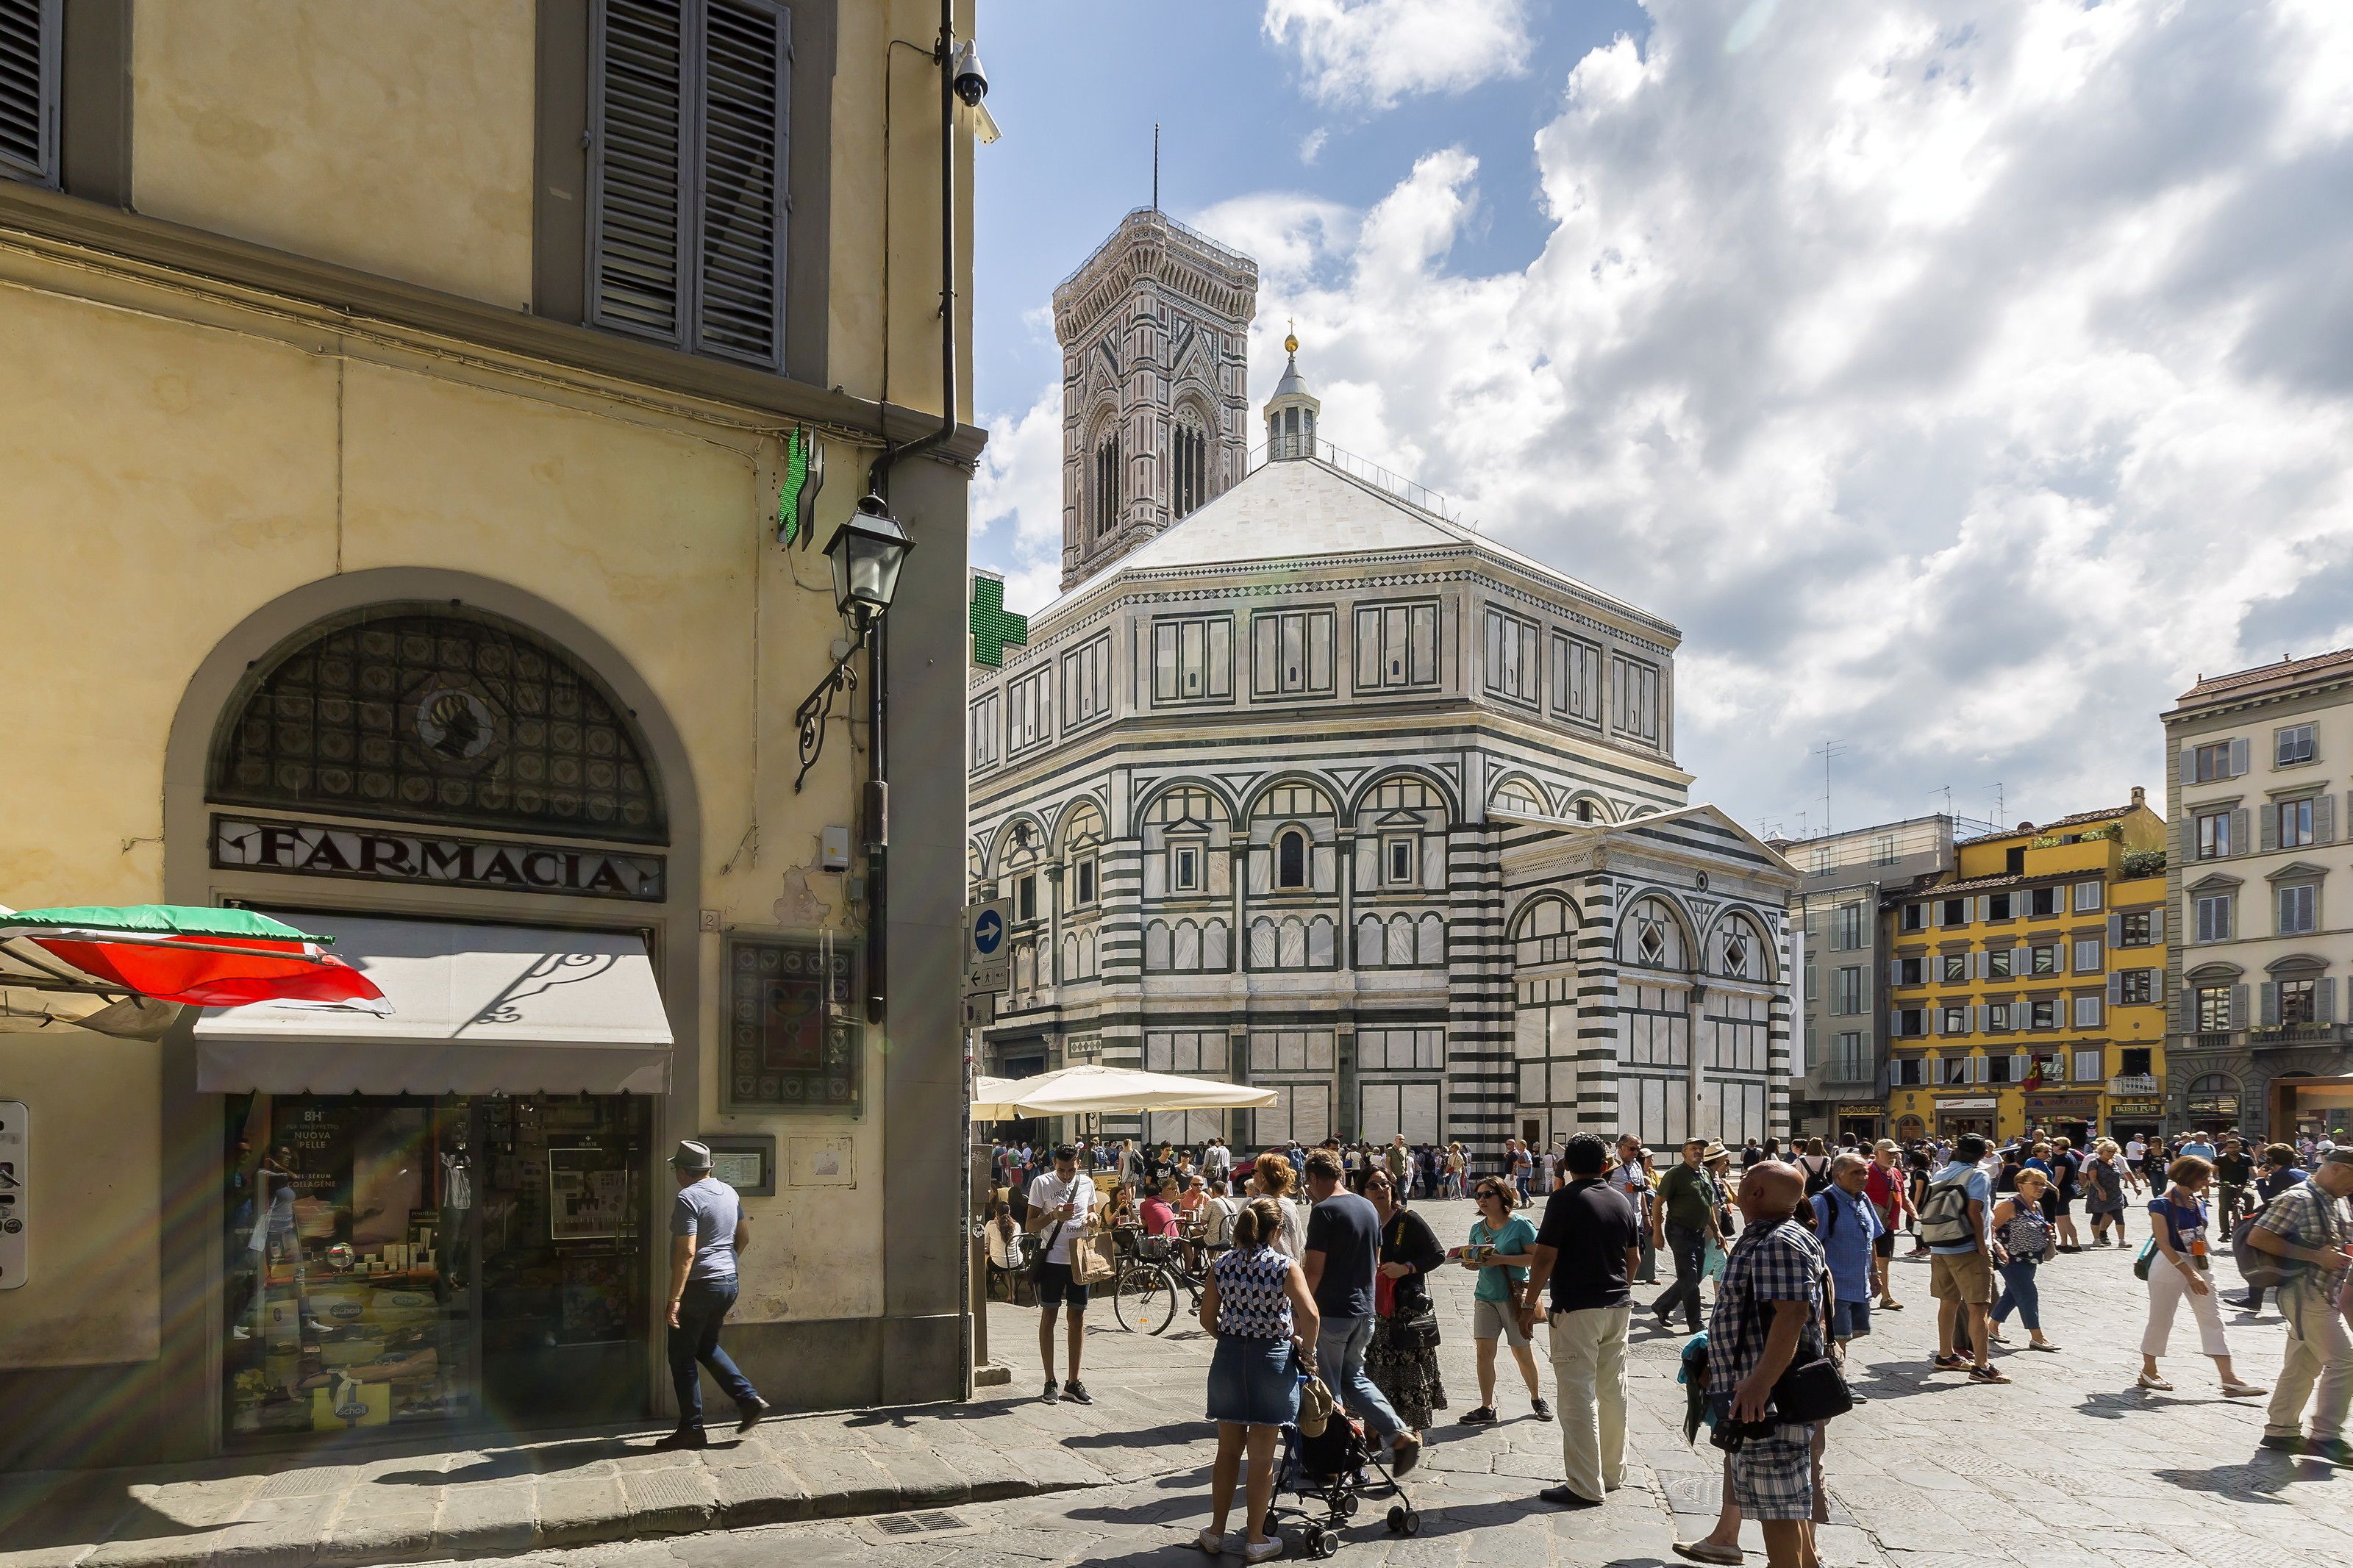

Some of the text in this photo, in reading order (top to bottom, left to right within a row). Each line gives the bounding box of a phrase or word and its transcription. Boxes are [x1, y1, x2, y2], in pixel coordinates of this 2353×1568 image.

[258, 825, 632, 895] FARMACIA
[706, 914, 714, 926] 2
[294, 1131, 331, 1139] NUOVA
[333, 1306, 360, 1315] Scholl
[339, 1406, 366, 1416] Scholl
